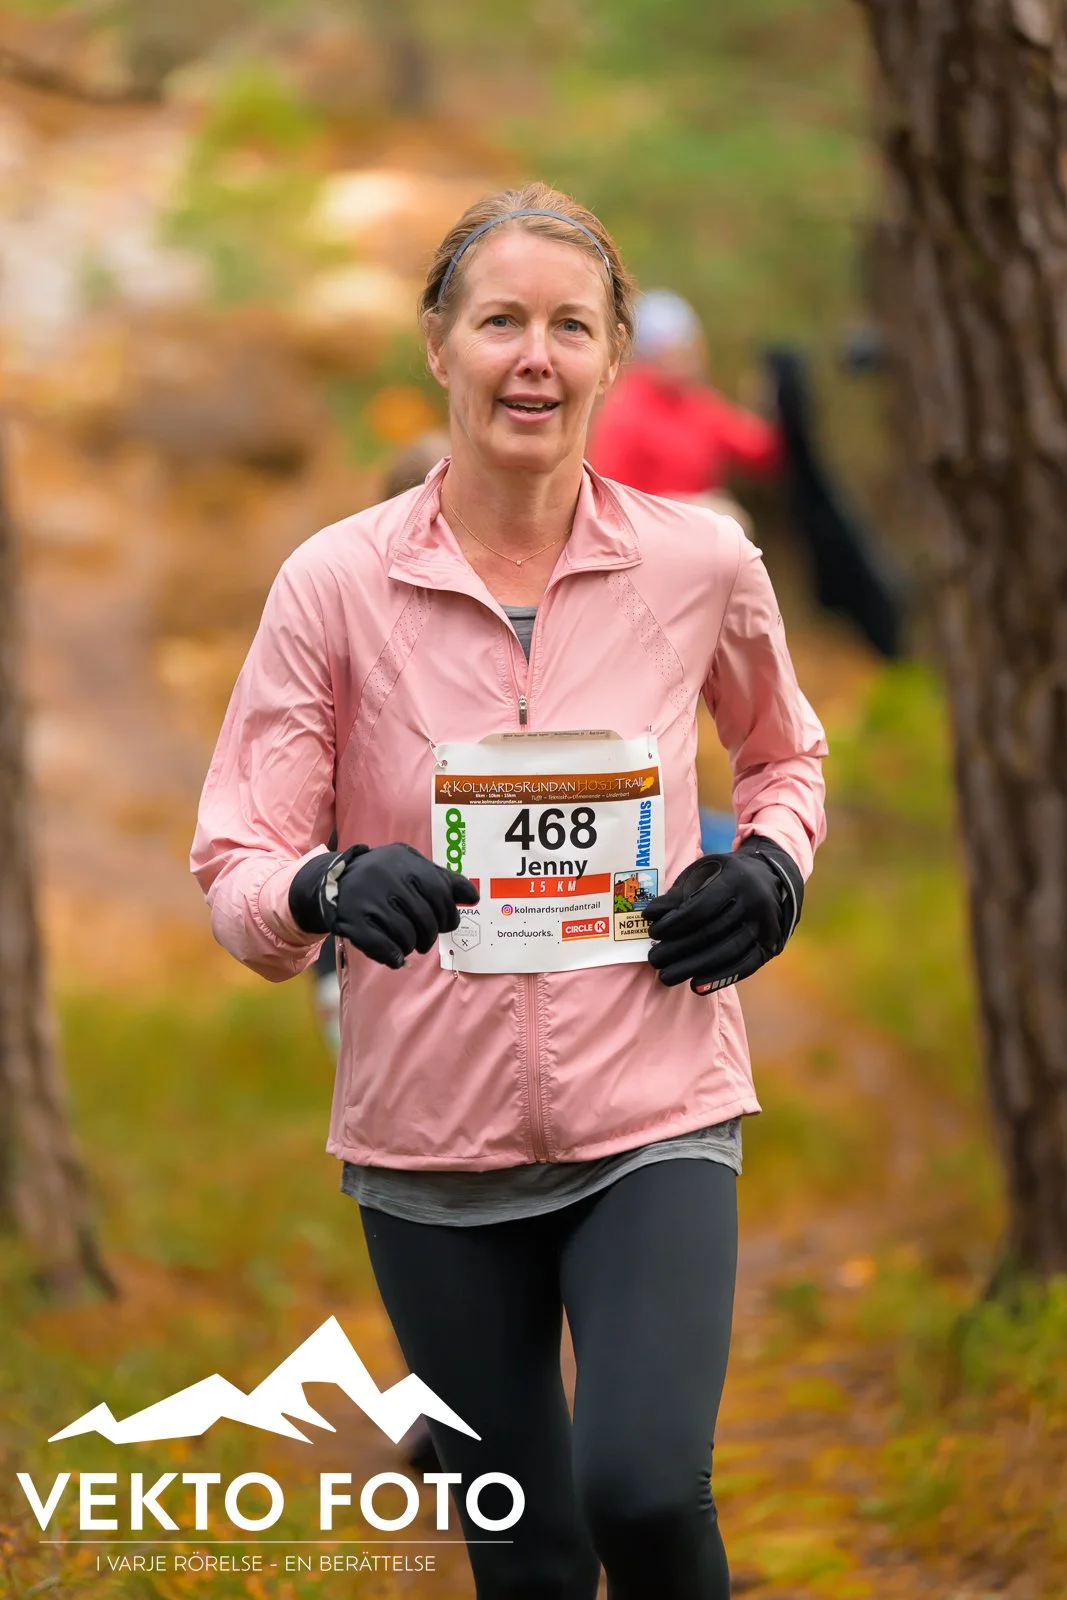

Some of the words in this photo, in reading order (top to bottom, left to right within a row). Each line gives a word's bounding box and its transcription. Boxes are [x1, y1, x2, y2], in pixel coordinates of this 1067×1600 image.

[504, 806, 598, 851] 468
[635, 800, 652, 867] Aktivitus
[516, 856, 588, 880] Jenny
[514, 900, 601, 914] kolmardsrundantrail
[497, 929, 554, 938] brandworks.
[565, 923, 593, 934] CIRCLE
